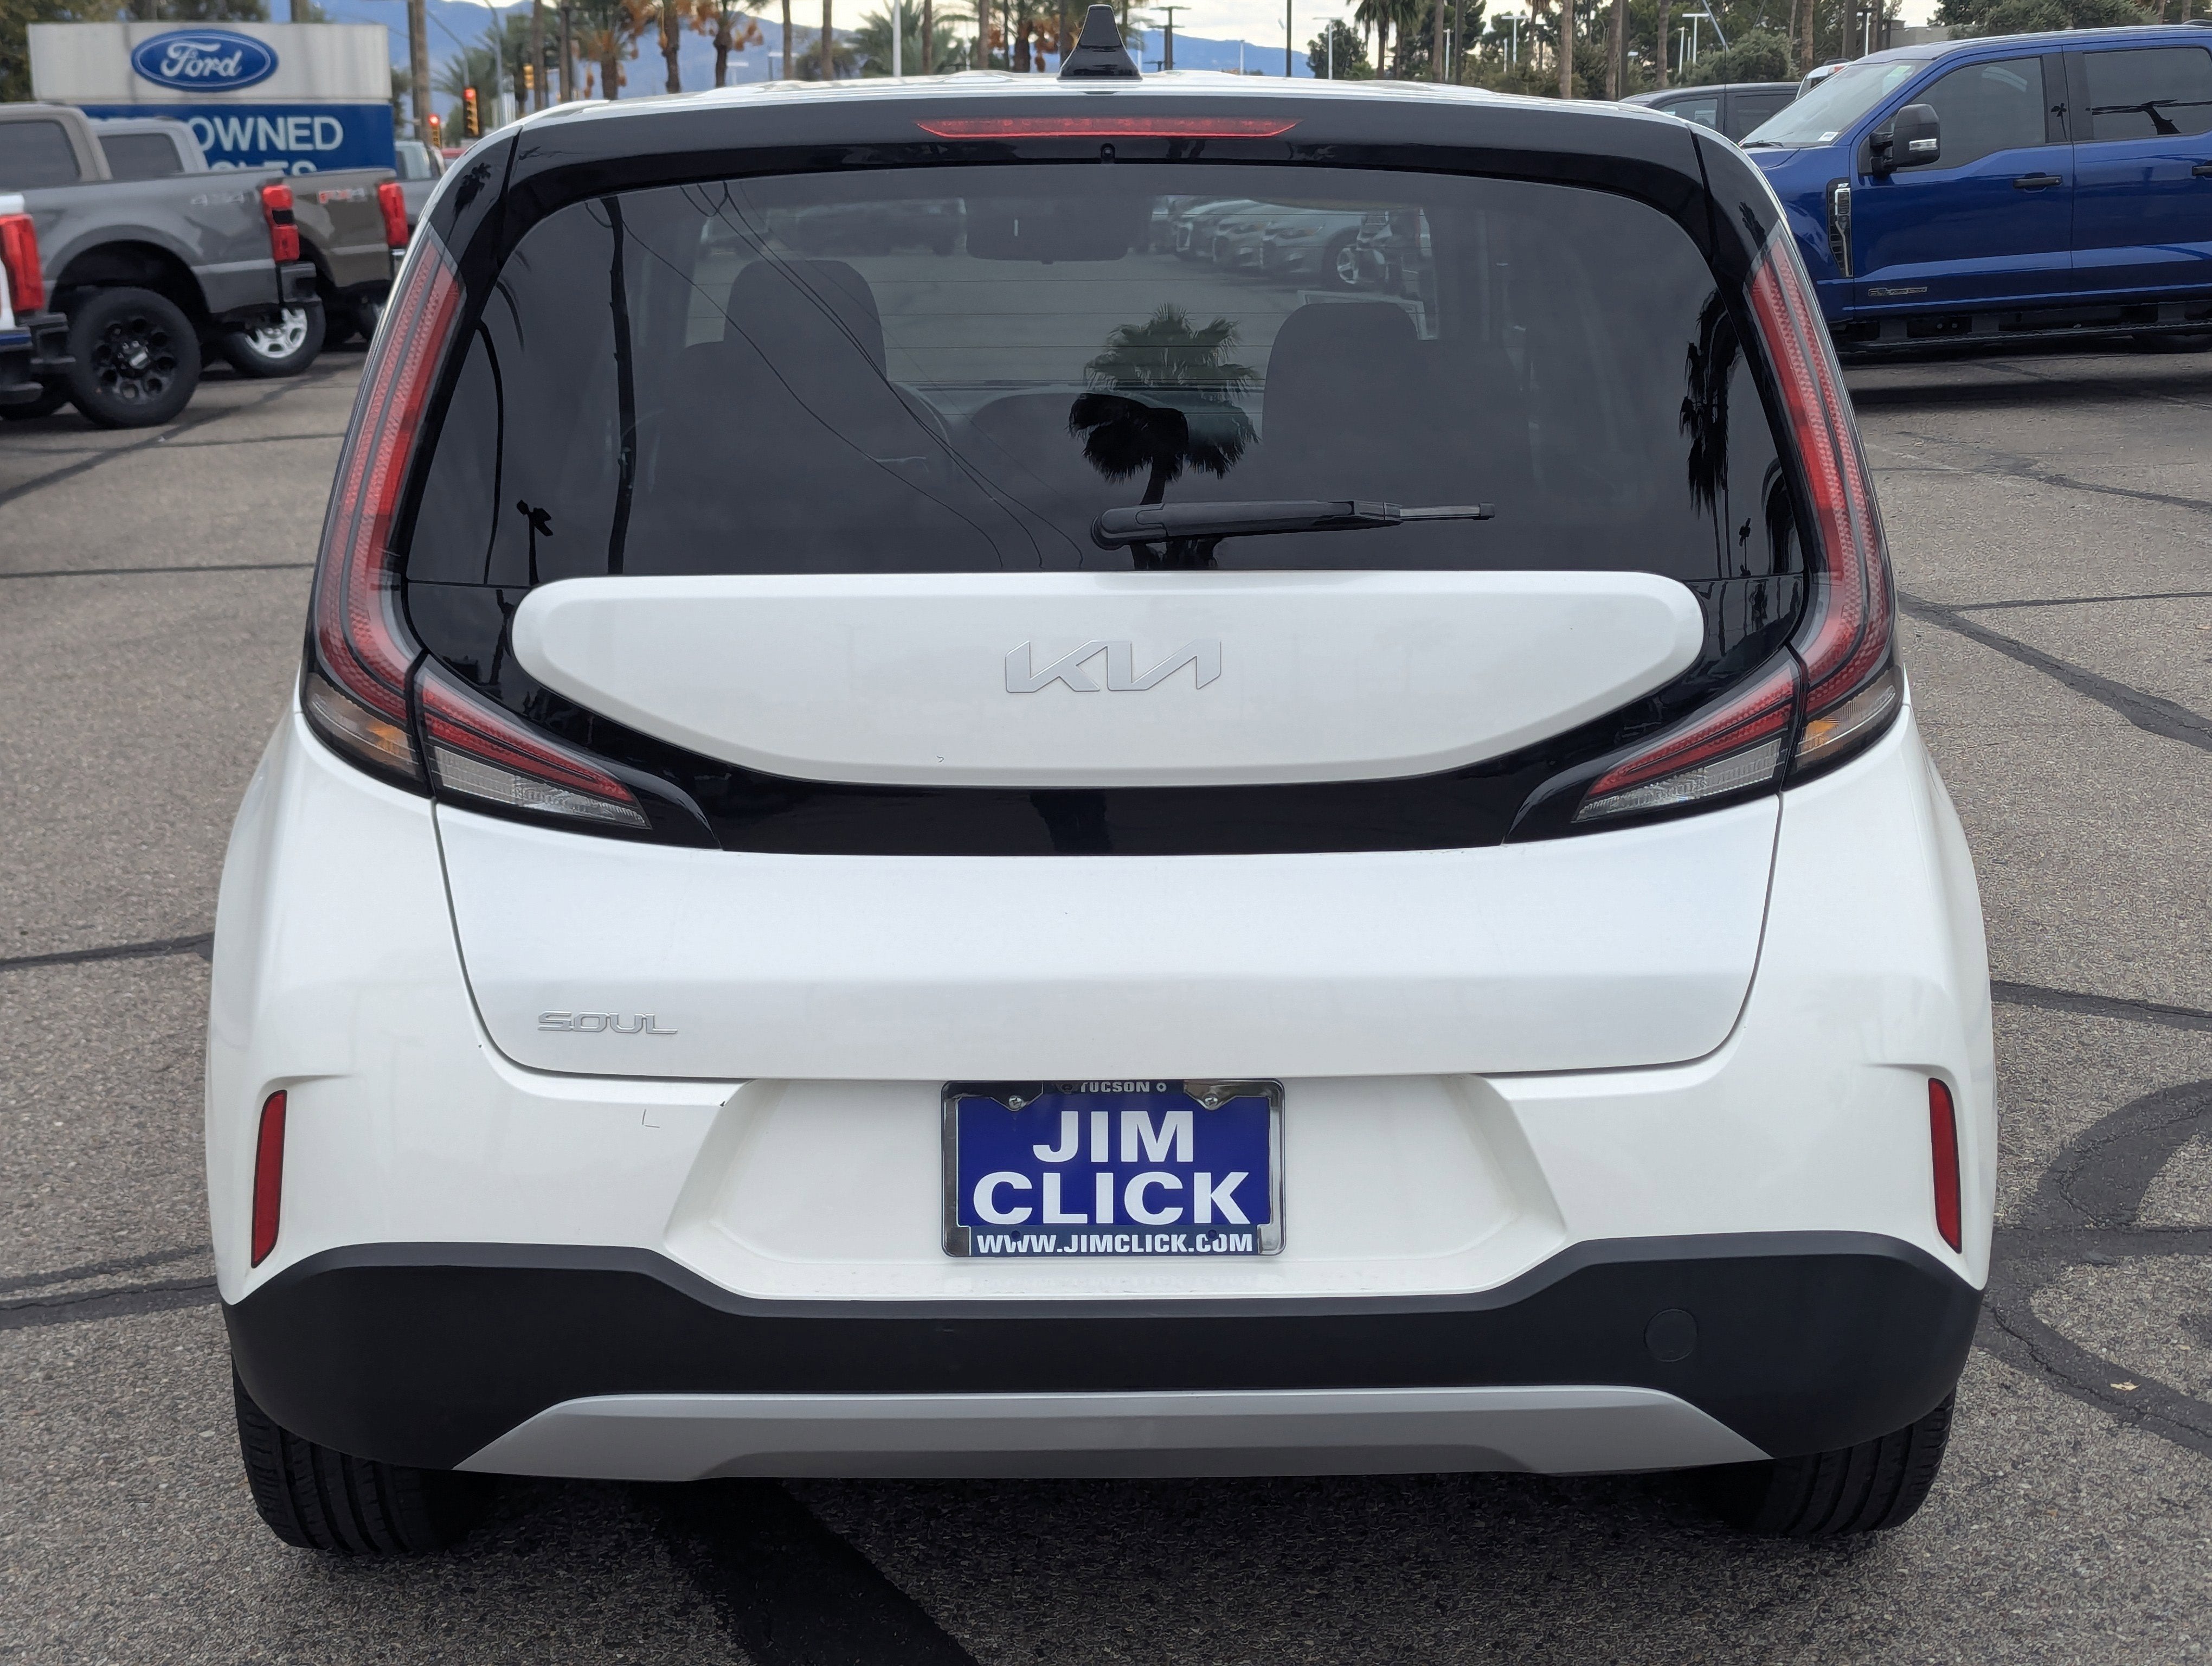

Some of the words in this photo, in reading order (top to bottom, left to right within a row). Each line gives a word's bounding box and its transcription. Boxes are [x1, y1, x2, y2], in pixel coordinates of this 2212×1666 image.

[160, 41, 243, 77] Ford
[1005, 638, 1221, 693] KIA
[538, 1010, 678, 1034] SOUL
[1033, 1111, 1193, 1163] JIM
[973, 1171, 1251, 1225] CLICK
[976, 1233, 1253, 1253] WWW.JIMCLICK.COM
